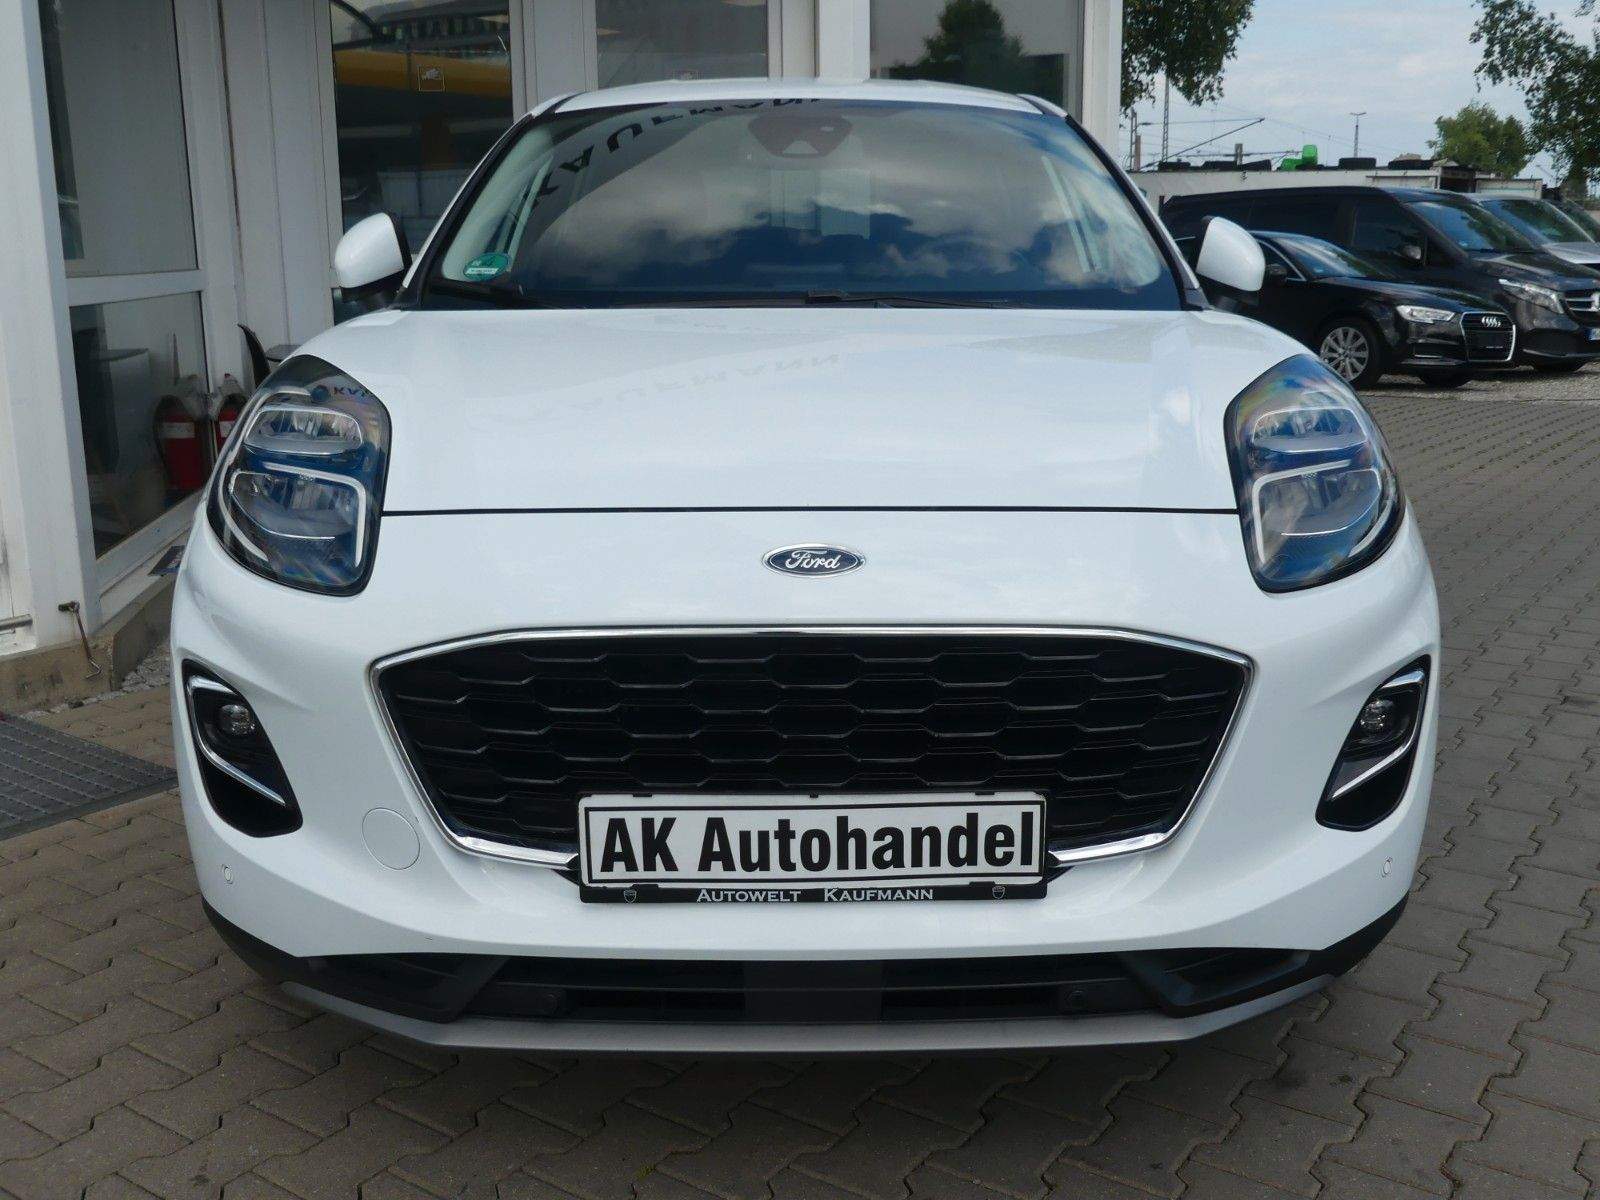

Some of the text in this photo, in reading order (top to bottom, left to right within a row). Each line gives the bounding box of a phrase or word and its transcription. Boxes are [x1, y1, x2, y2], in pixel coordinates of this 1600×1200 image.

[785, 550, 841, 569] Ford
[600, 811, 1034, 873] AK Autohandel
[696, 888, 934, 903] AUTOWELT KAUFMANN
